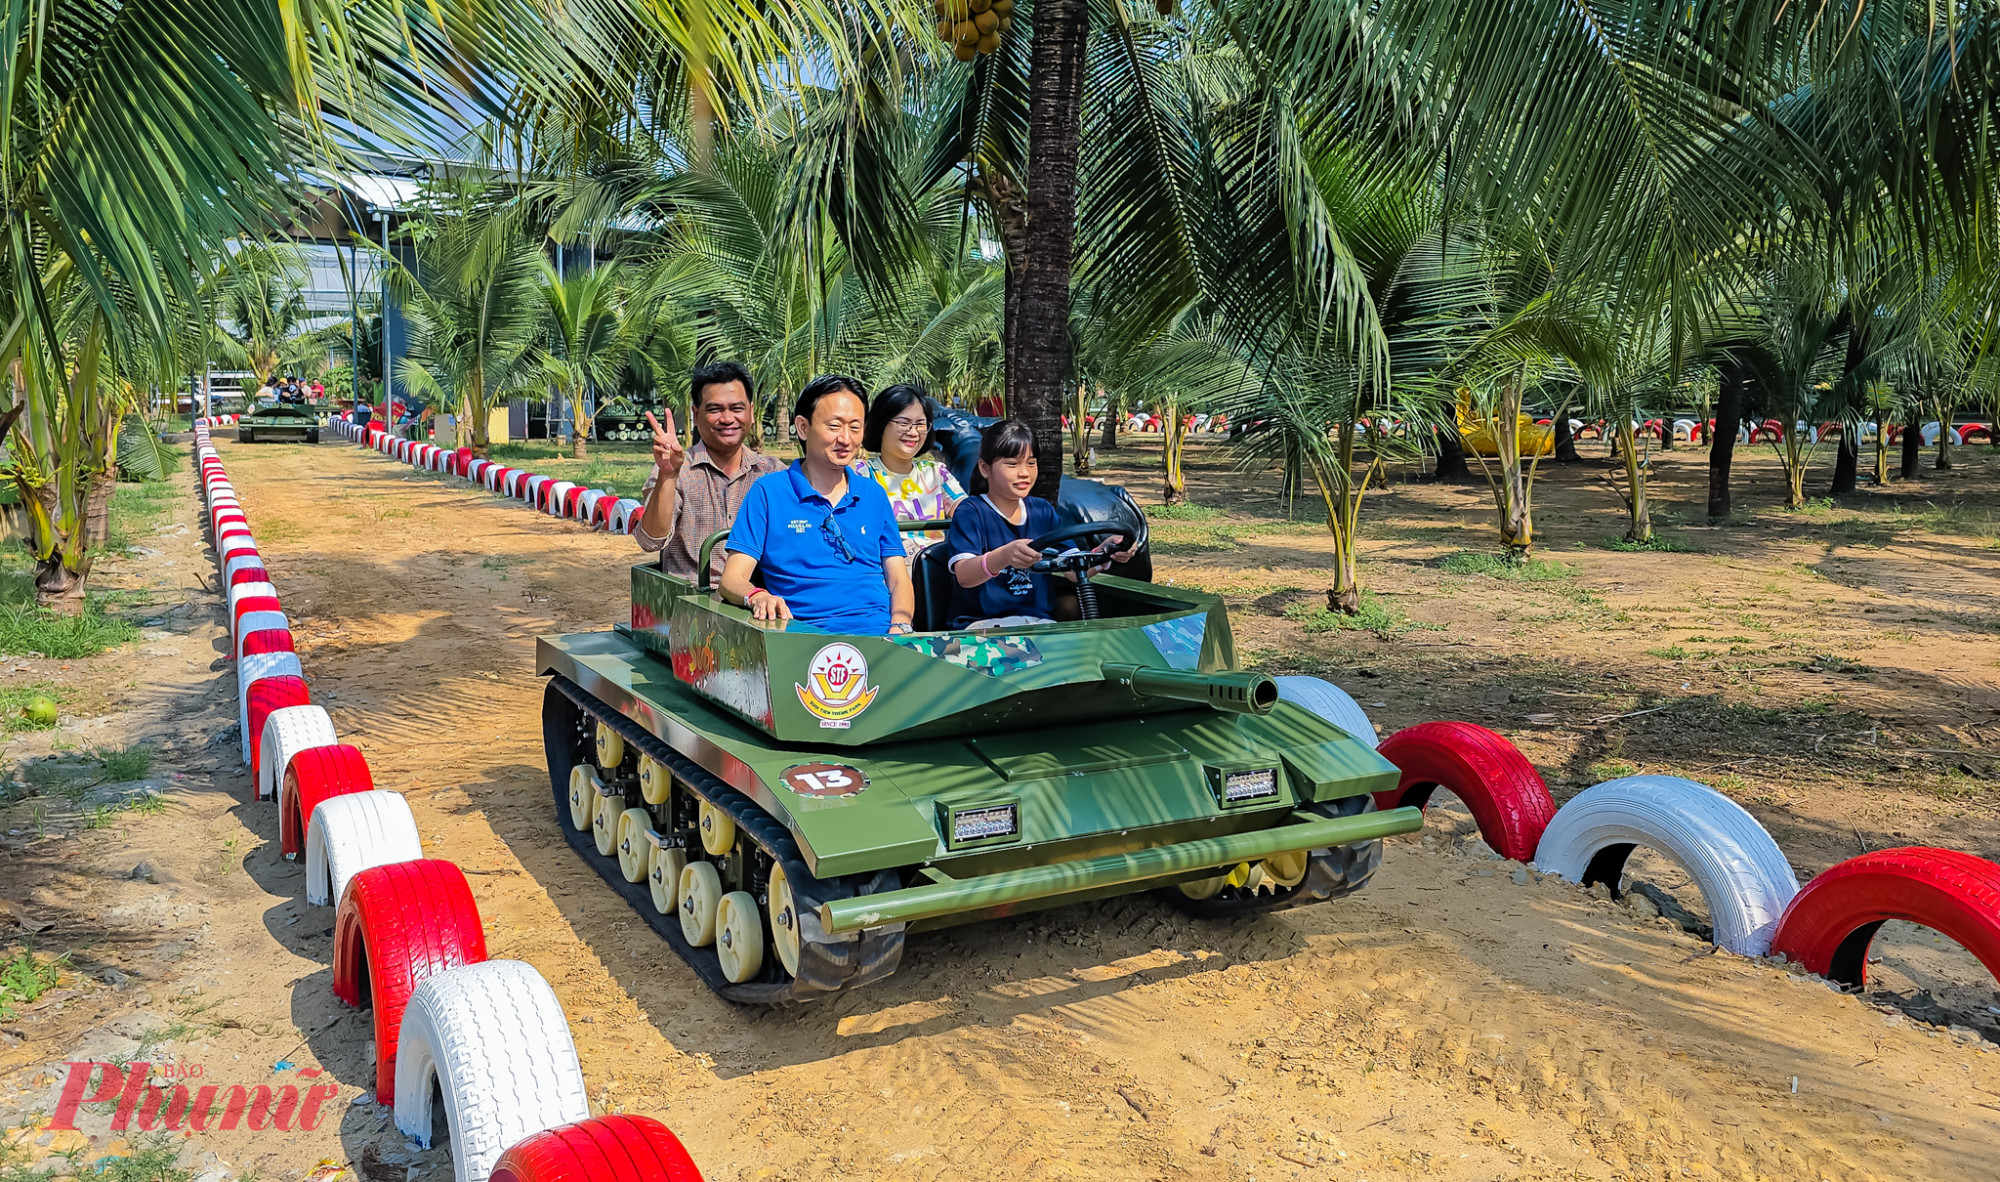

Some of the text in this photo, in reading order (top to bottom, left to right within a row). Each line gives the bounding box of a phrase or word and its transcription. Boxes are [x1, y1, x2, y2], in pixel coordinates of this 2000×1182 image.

[829, 666, 847, 684] STF
[849, 702, 862, 713] PARK
[793, 769, 853, 791] 13
